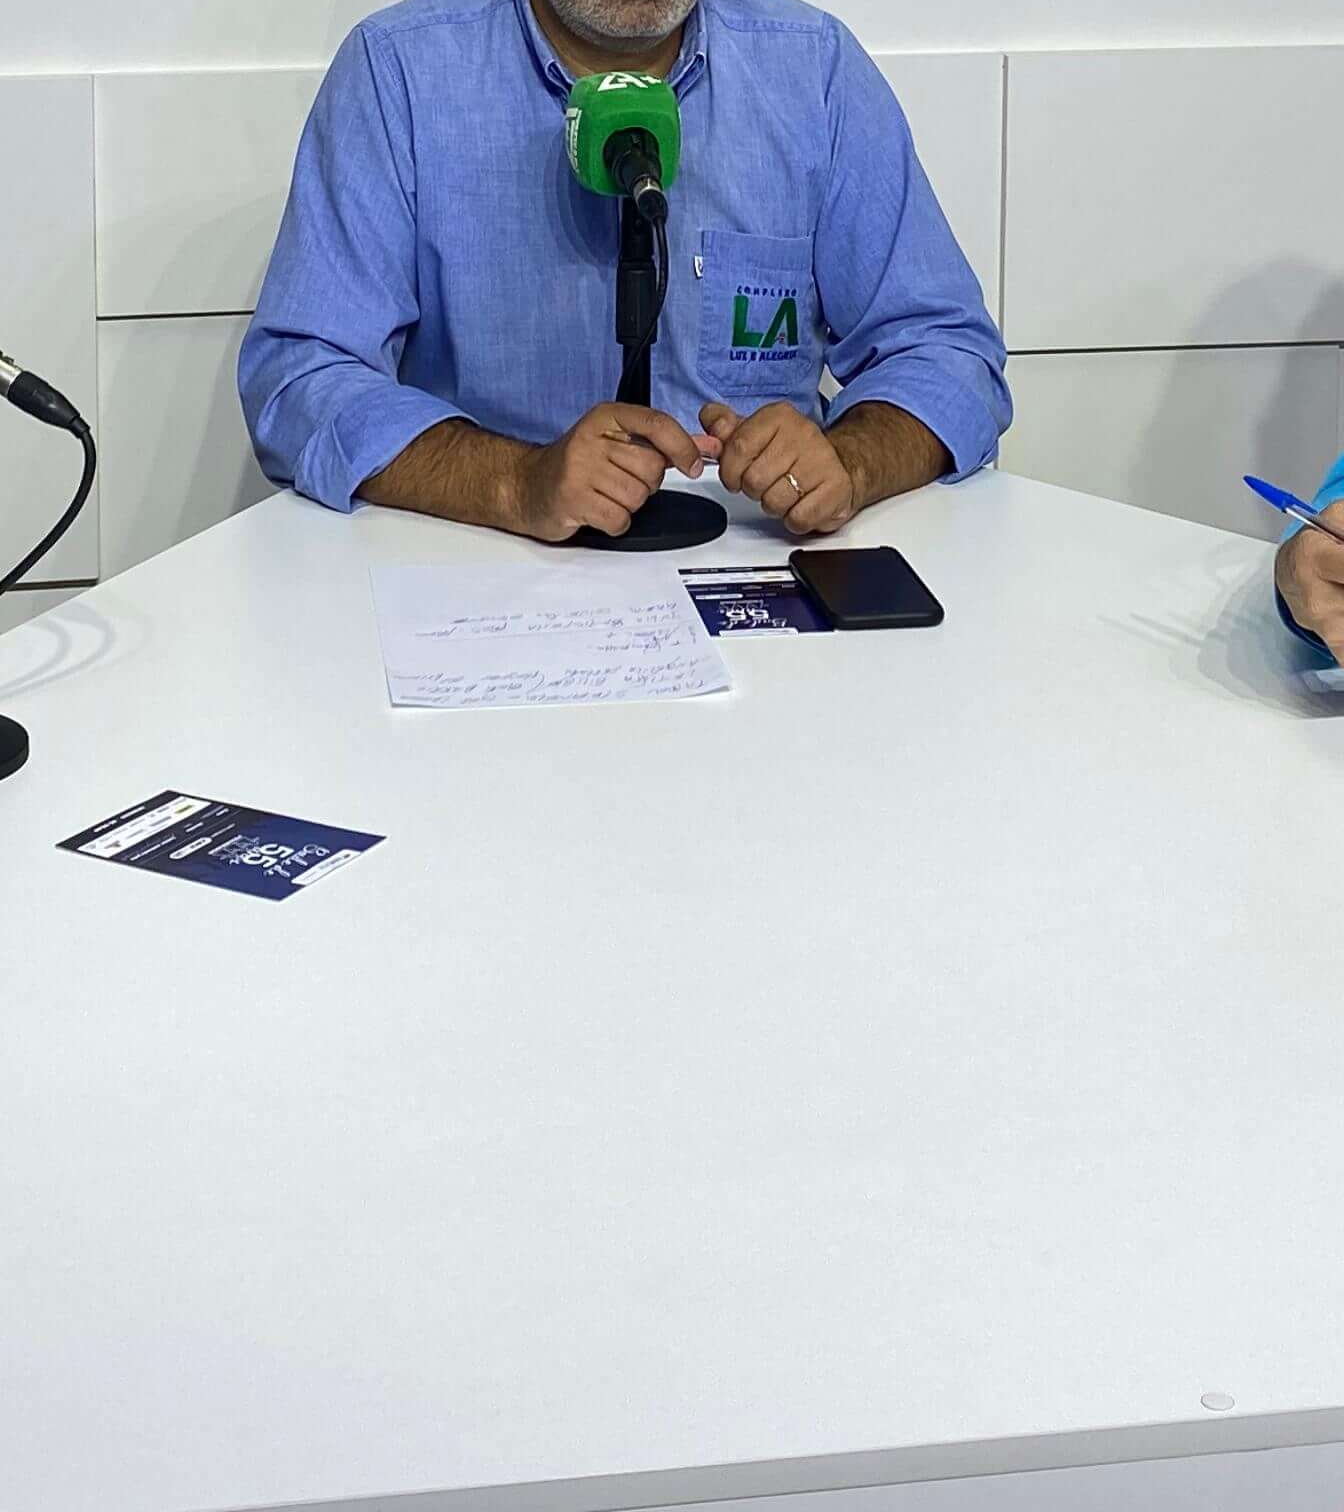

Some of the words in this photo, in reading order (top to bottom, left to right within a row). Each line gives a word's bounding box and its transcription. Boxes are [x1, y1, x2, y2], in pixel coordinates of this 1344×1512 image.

[732, 295, 799, 348] LA
[729, 350, 747, 362] LUZ
[243, 843, 294, 868] 55
